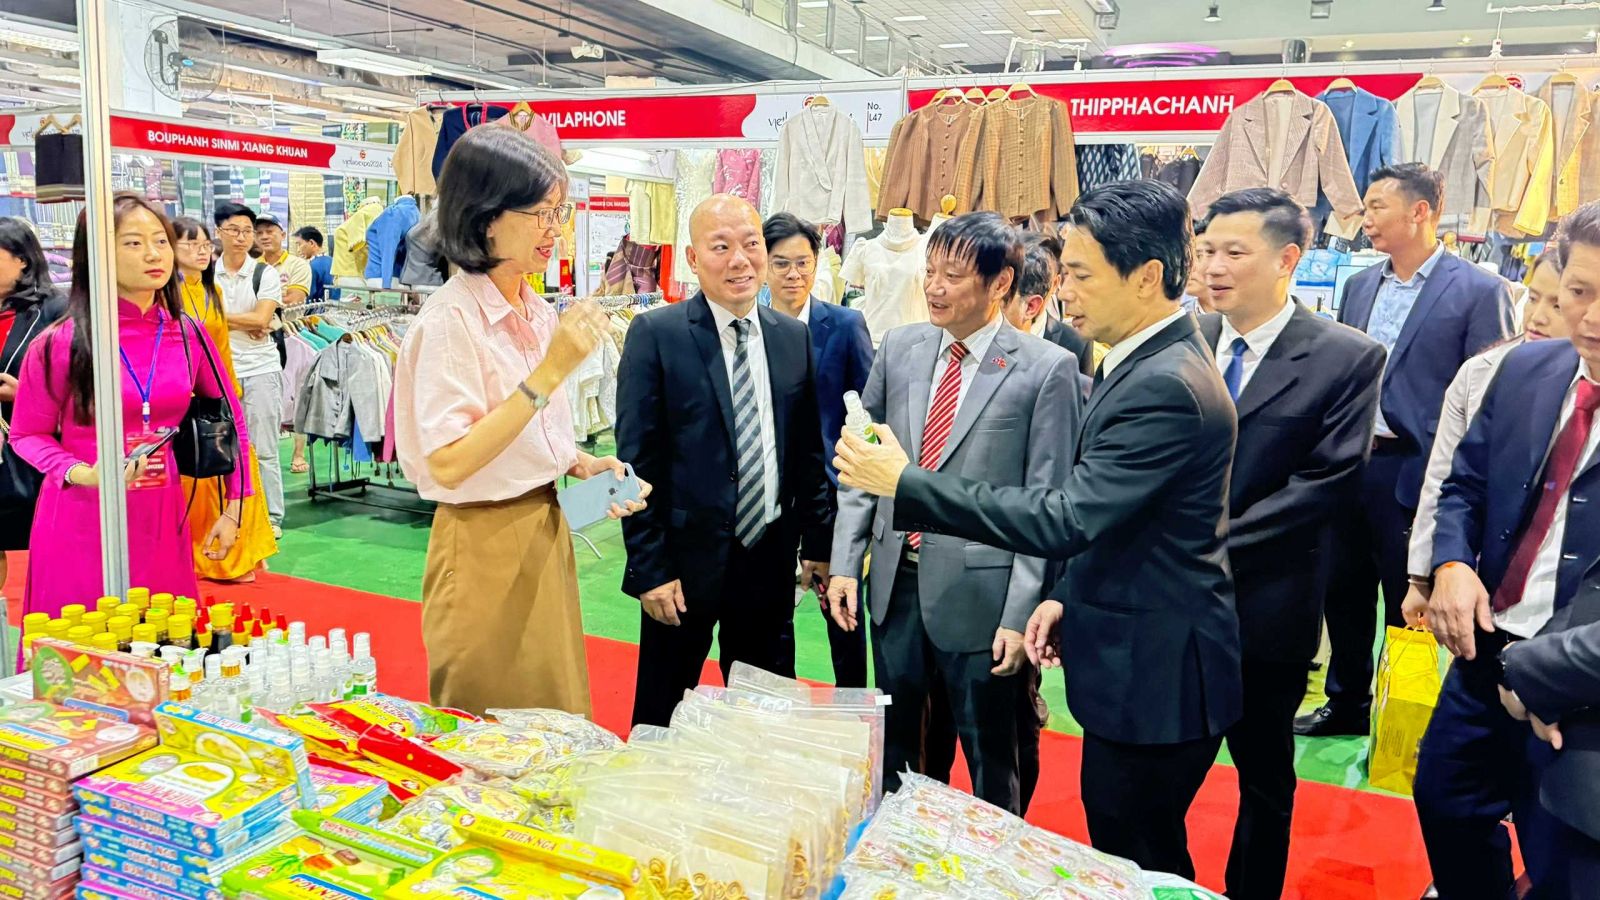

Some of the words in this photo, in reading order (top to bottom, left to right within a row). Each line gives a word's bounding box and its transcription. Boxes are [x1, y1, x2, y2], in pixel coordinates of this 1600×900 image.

[867, 102, 881, 110] No.
[1070, 95, 1235, 116] THIPPHACHANH
[542, 110, 626, 128] VILAPHONE
[148, 130, 209, 148] BOUPHANH
[212, 139, 240, 151] SINMI
[241, 142, 274, 155] XIANG
[276, 145, 308, 158] KHUAN
